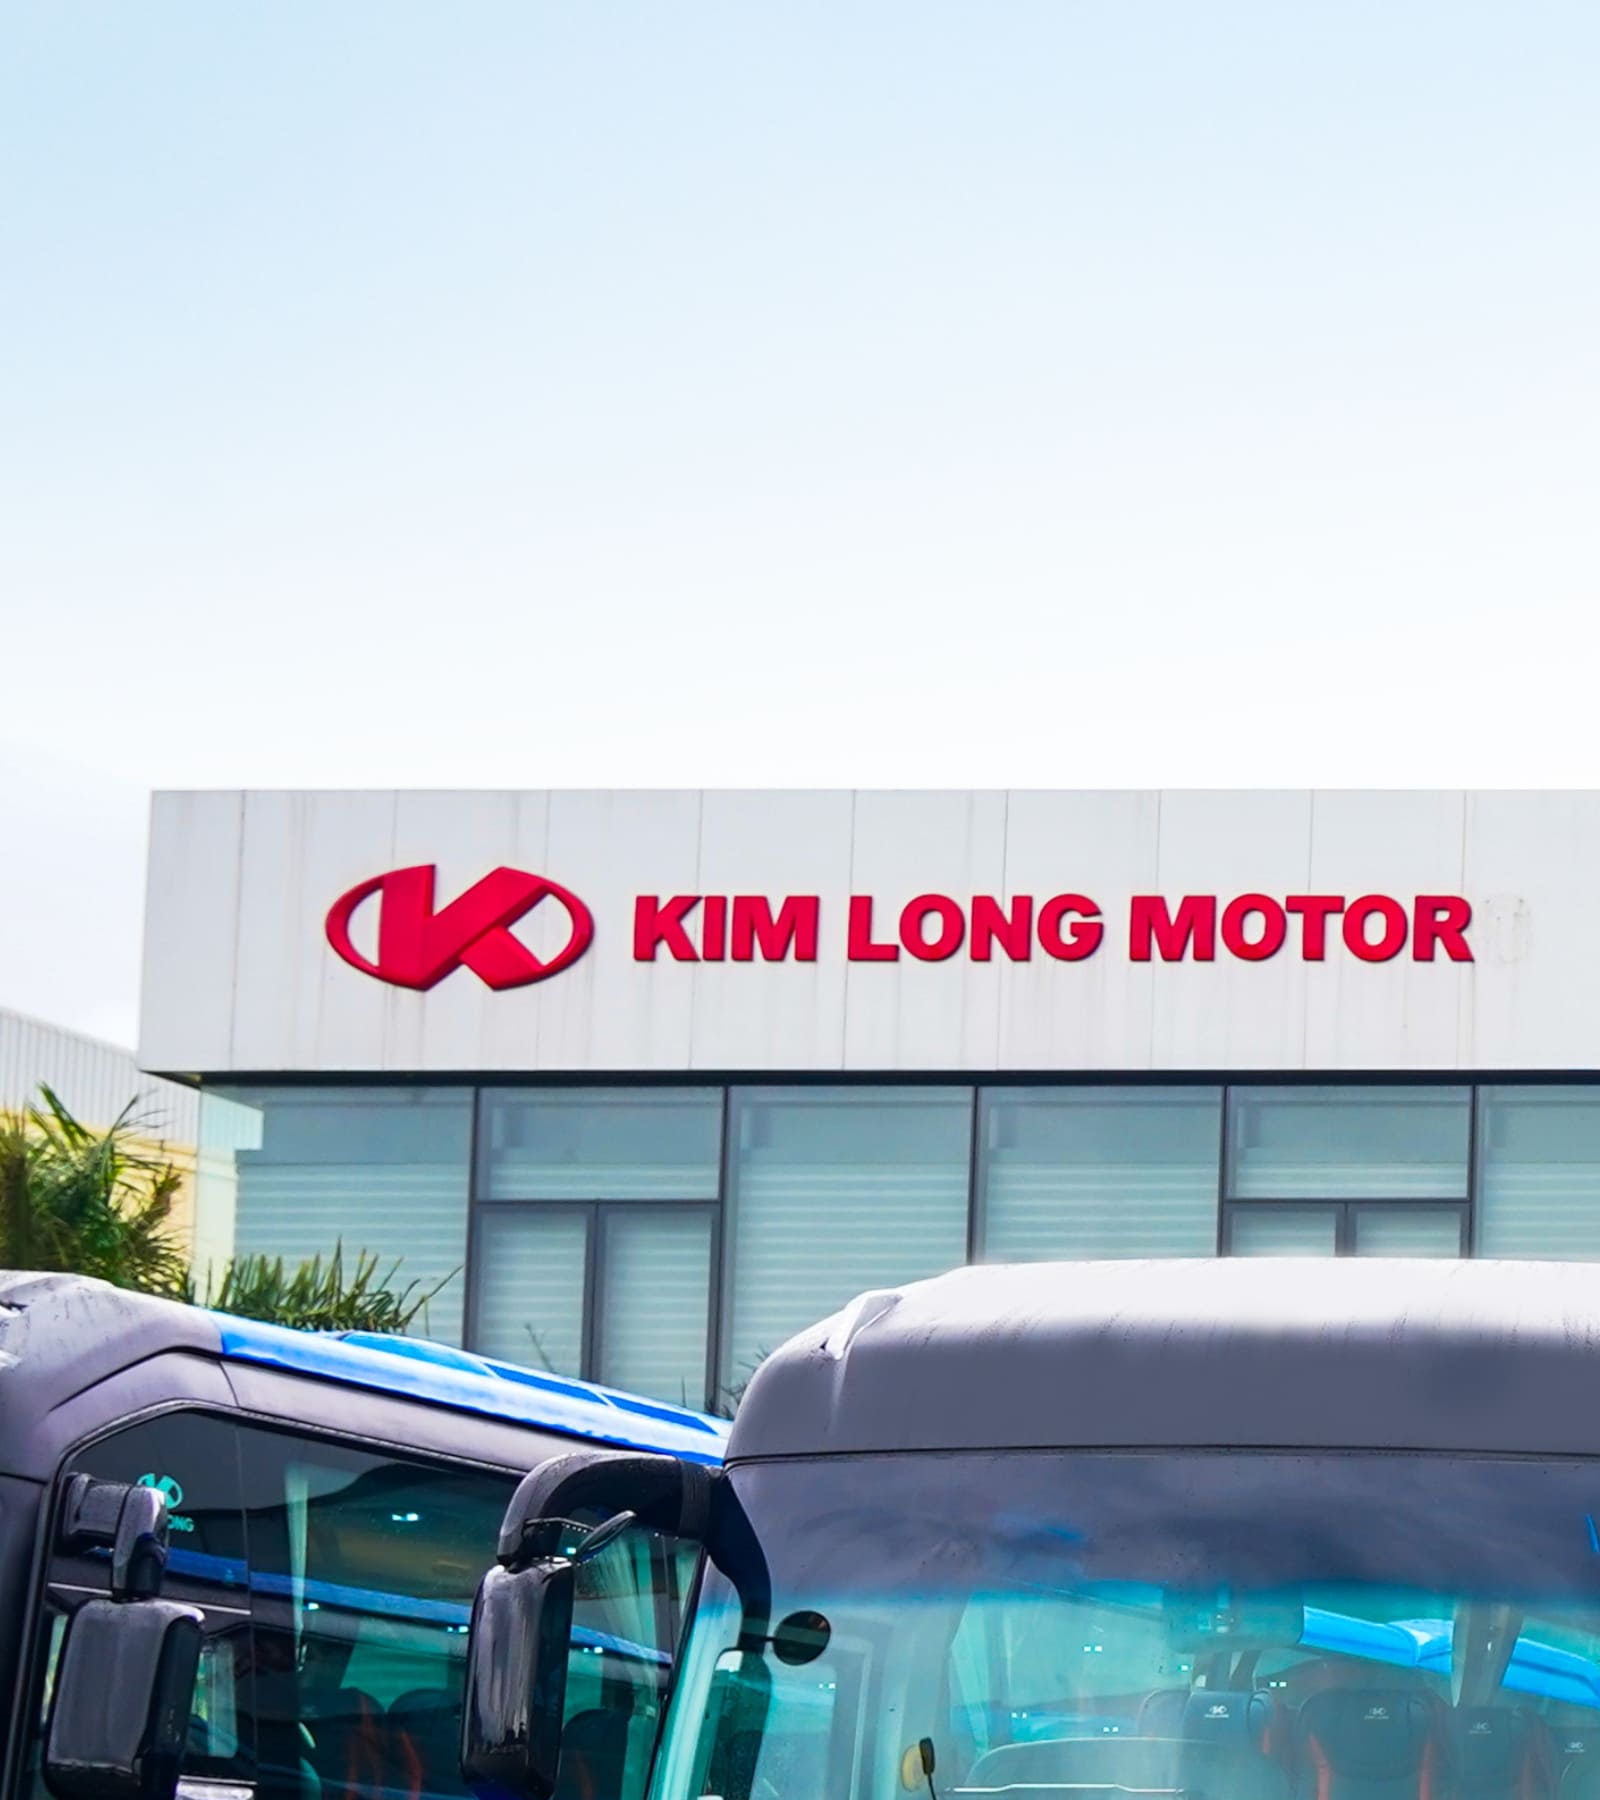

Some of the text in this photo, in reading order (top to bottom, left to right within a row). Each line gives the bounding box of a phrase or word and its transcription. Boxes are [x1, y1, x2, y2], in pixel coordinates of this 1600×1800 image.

[633, 892, 1474, 963] KIM LONG MOTOR
